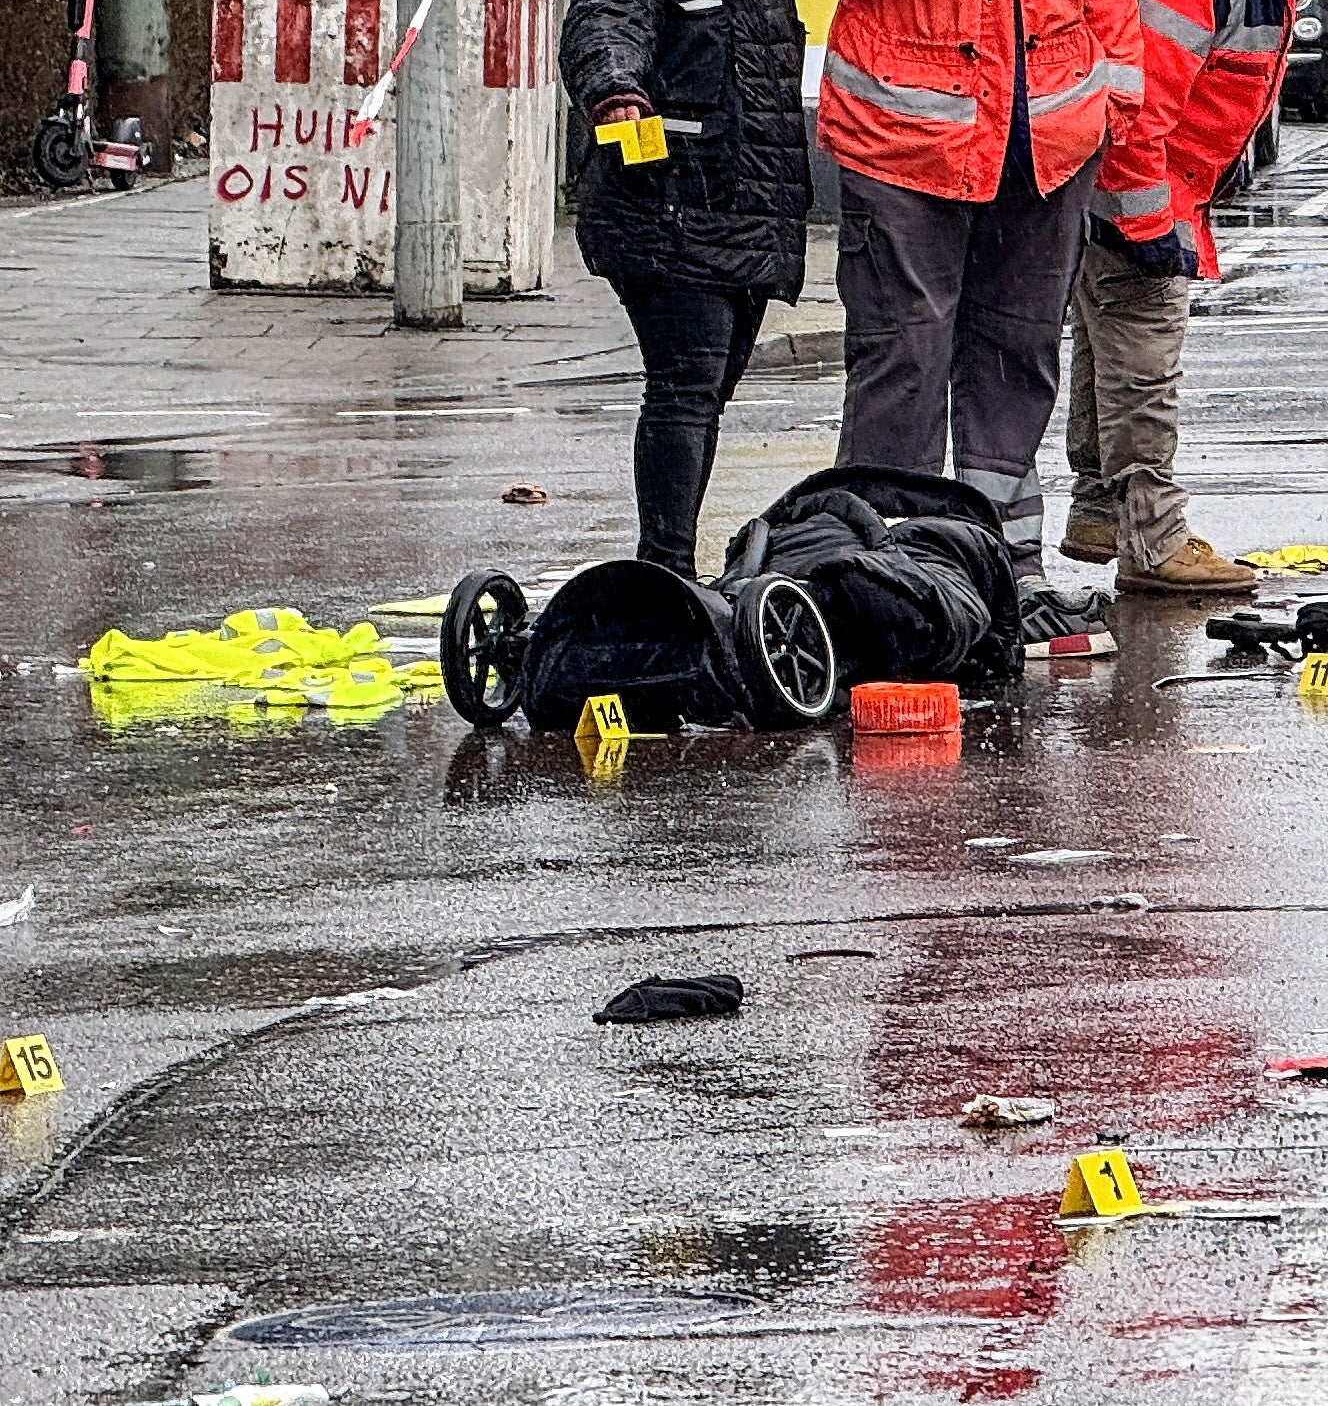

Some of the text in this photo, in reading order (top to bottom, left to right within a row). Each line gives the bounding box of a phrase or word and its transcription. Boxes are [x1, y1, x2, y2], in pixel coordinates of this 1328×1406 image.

[216, 164, 308, 203] OIS
[596, 701, 623, 730] 14
[16, 1044, 53, 1082] 15
[1099, 1160, 1123, 1201] 1
